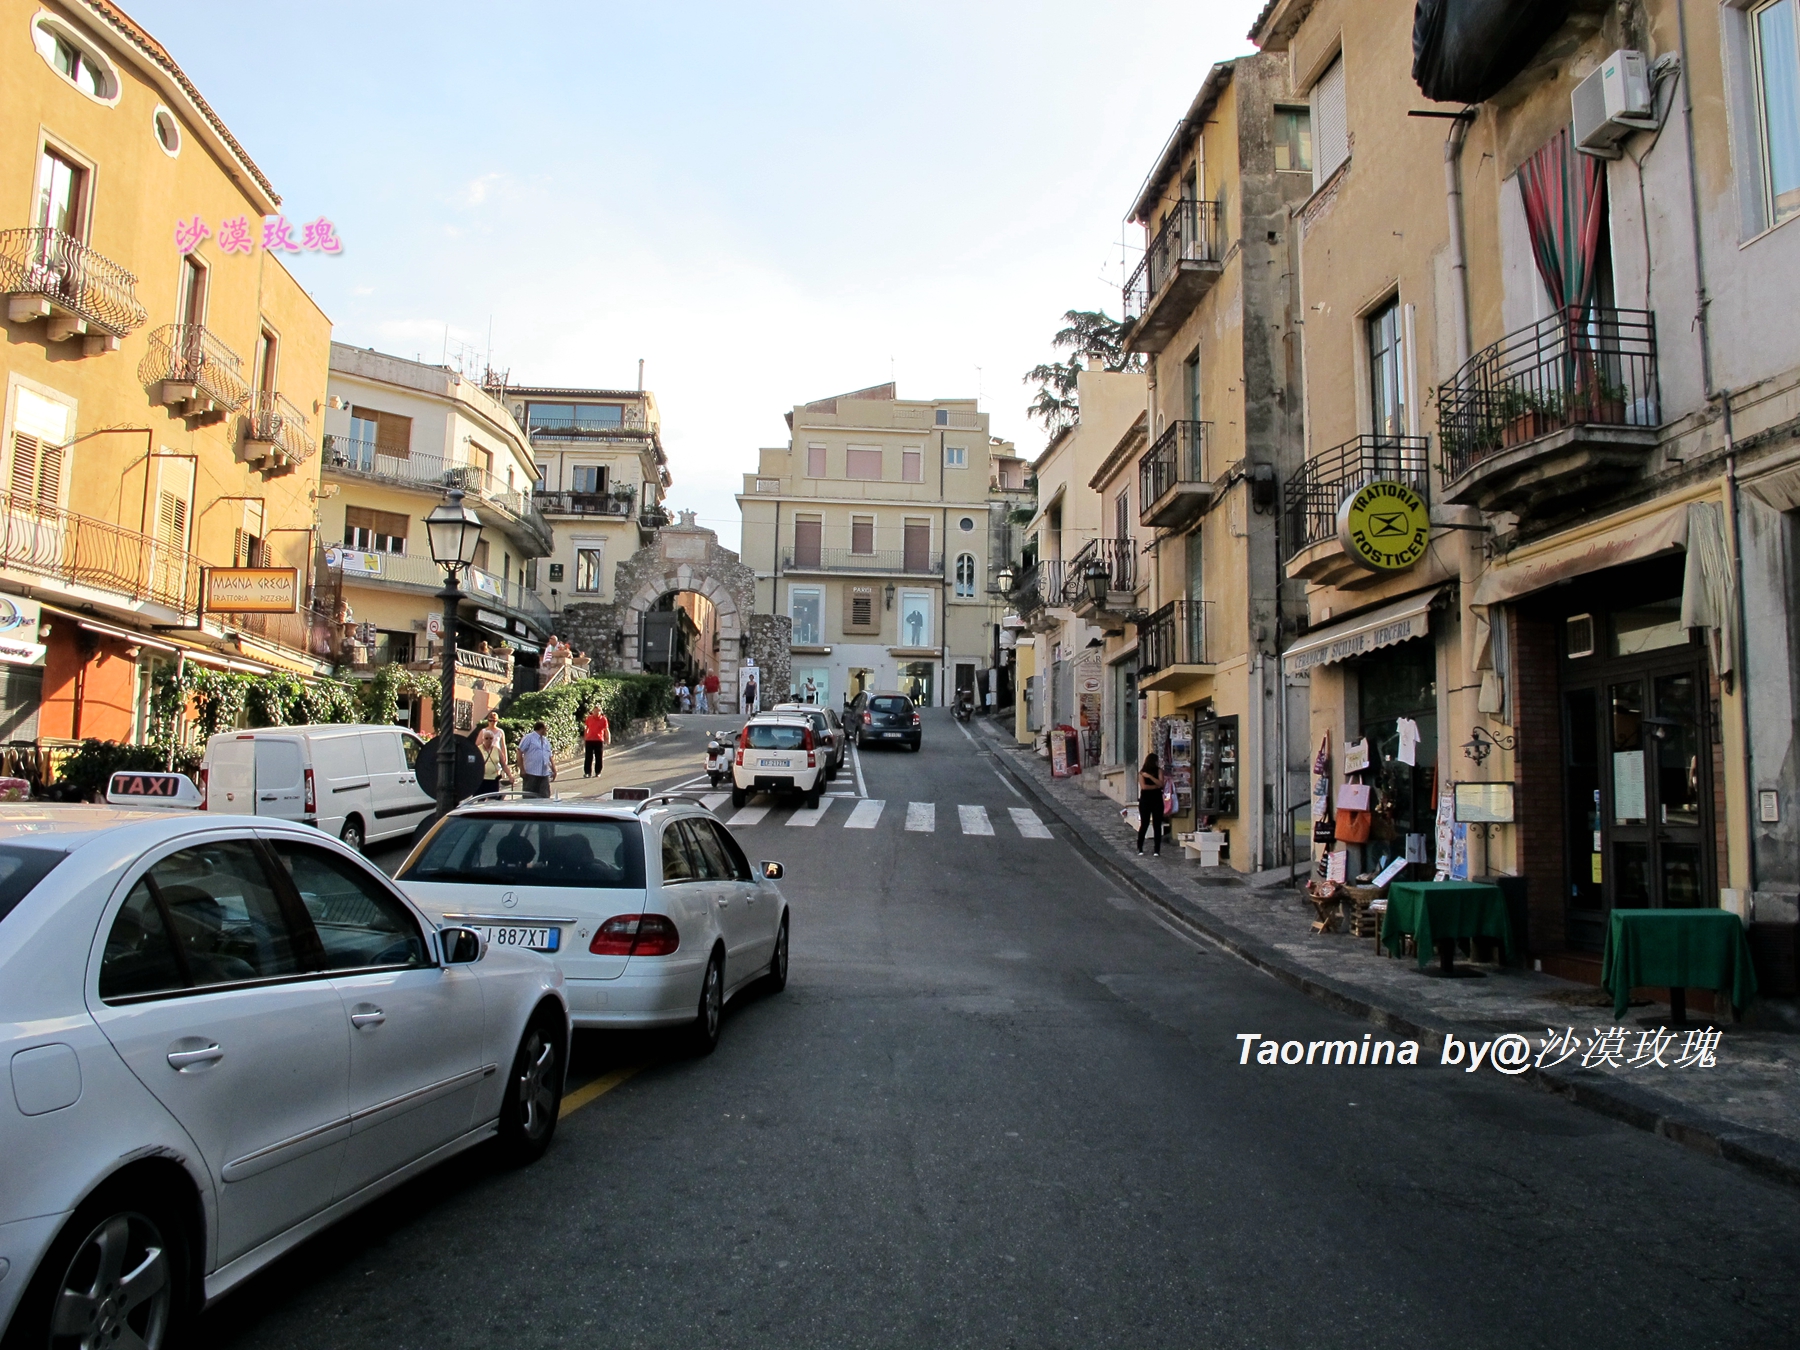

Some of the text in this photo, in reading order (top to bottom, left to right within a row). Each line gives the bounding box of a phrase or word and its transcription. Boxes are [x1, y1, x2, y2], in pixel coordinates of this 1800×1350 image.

[1353, 484, 1419, 513] TRATTORIA
[212, 576, 291, 590] MAGNA GRECIA
[213, 594, 290, 603] TRATTORIA PIZZERIA
[1294, 620, 1411, 669] CERAMICHE SICILIANE MERCERIA
[114, 775, 174, 796] TAXI
[497, 928, 548, 947] 887XT
